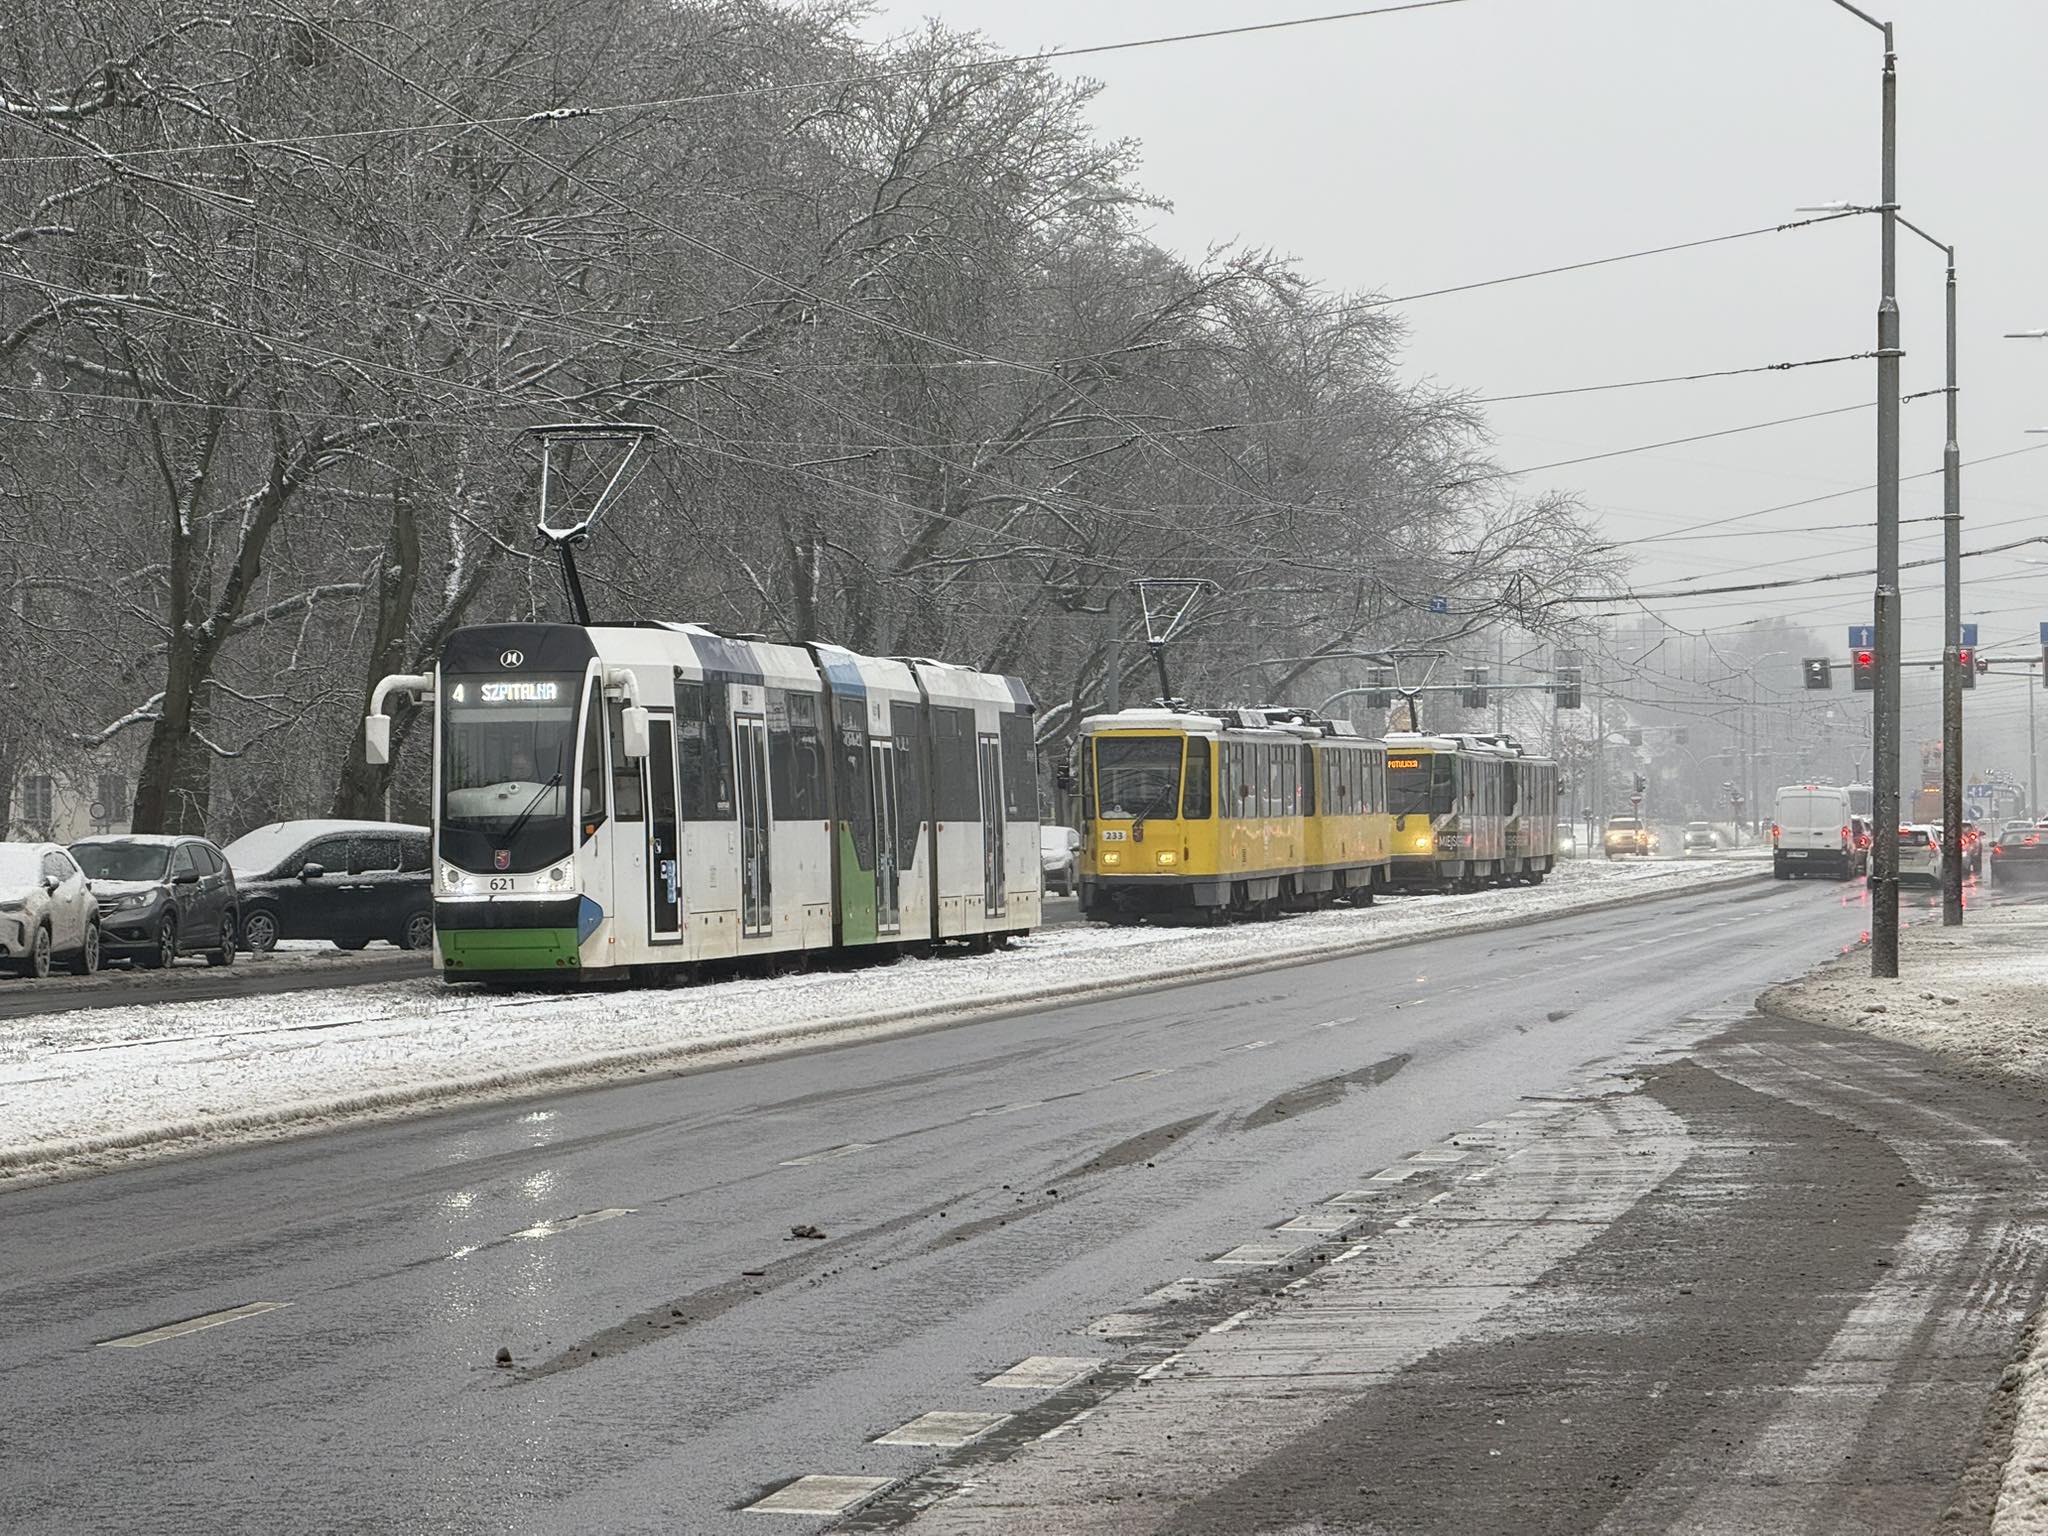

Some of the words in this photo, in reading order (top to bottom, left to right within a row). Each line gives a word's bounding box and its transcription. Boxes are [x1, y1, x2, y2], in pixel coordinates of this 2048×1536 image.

[452, 683, 464, 702] 4
[481, 682, 557, 701] SZPITALNA
[1105, 831, 1124, 840] 233
[490, 878, 515, 891] 621
